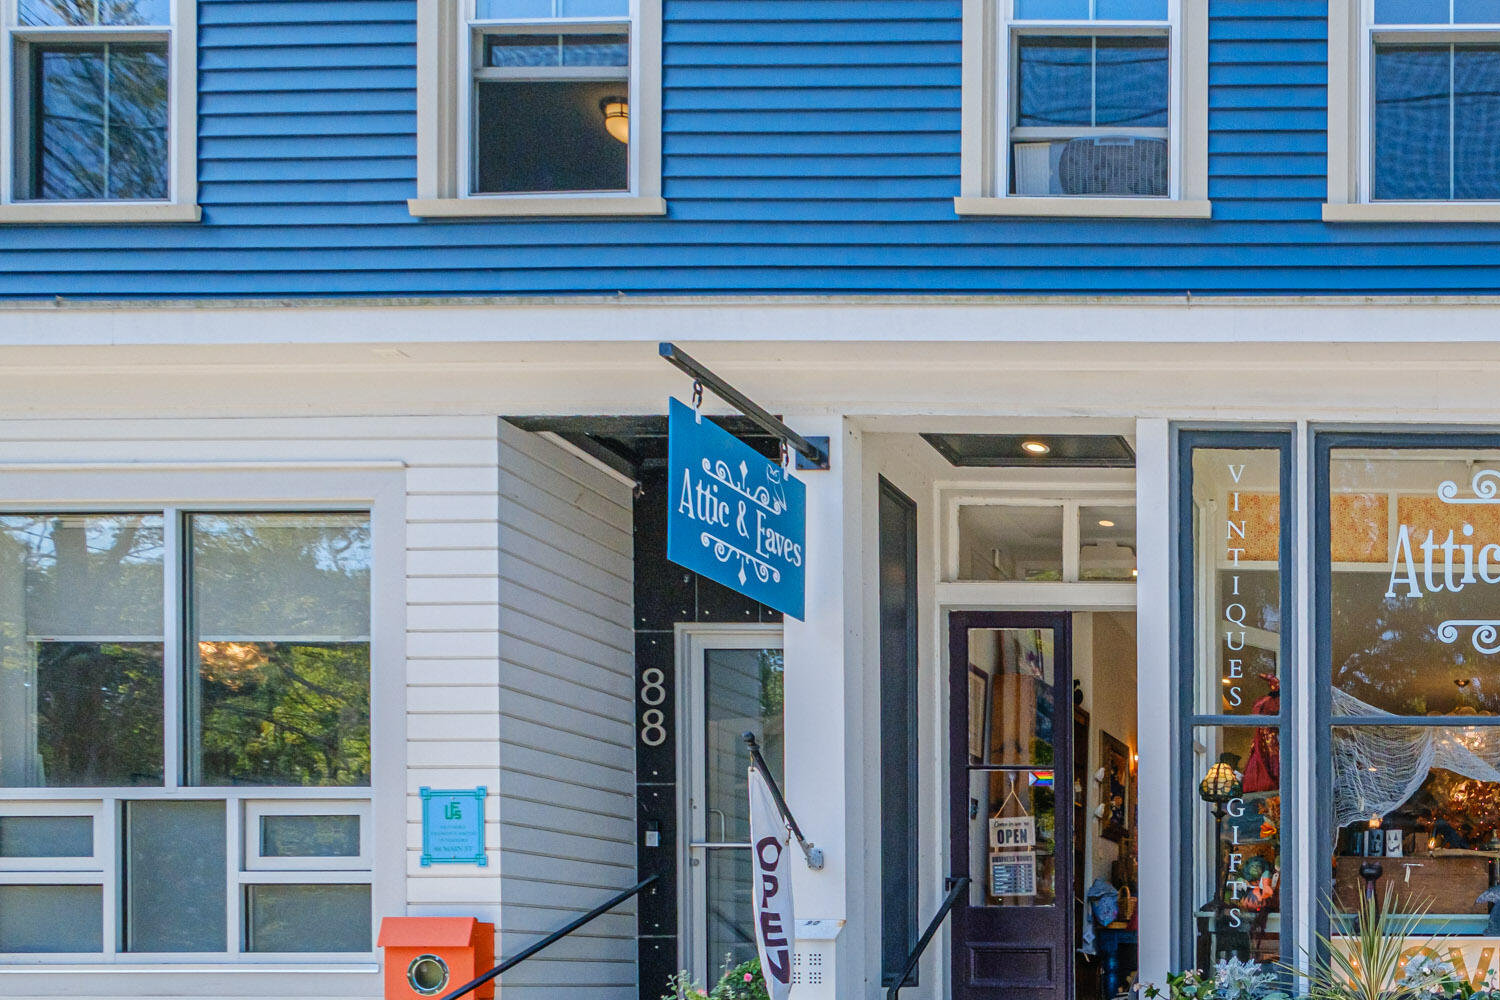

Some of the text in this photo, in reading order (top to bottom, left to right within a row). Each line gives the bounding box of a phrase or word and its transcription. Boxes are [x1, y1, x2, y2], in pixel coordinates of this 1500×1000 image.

[678, 468, 802, 567] Attic & Eaves
[1226, 464, 1247, 707] VINTIQUES
[641, 667, 666, 747] 88
[997, 829, 1028, 844] OPEN
[1226, 798, 1246, 928] GIFTS
